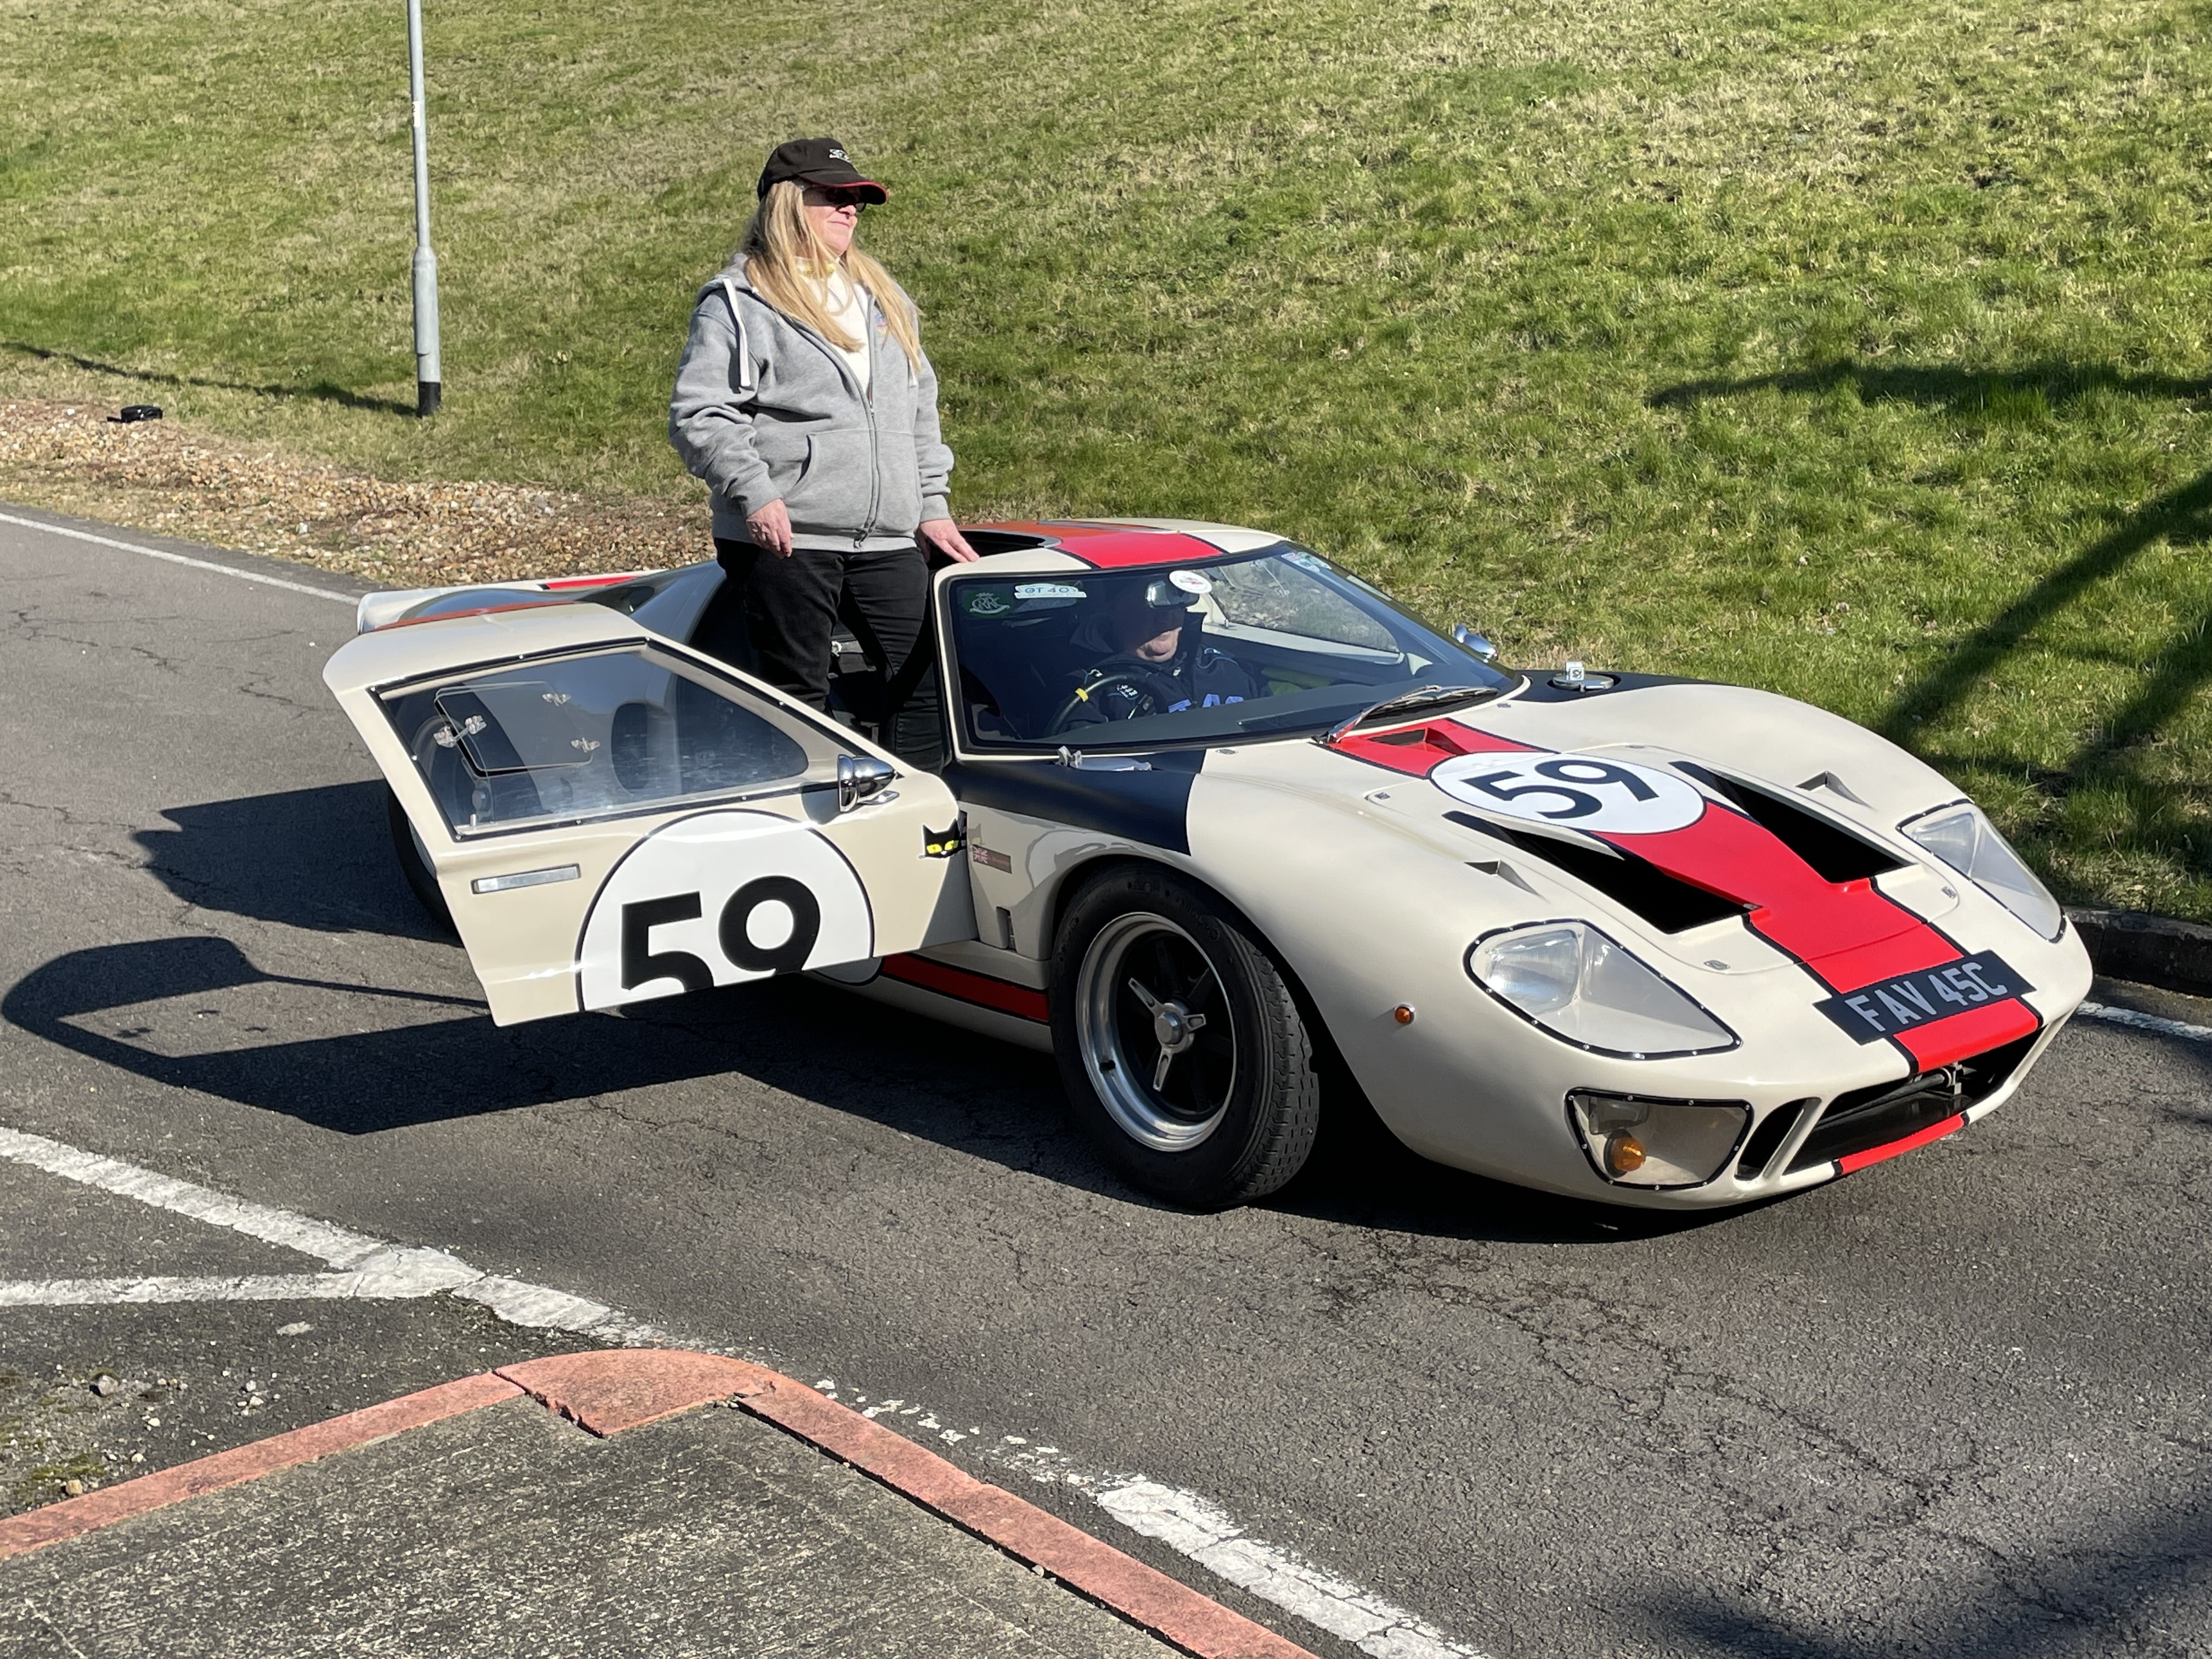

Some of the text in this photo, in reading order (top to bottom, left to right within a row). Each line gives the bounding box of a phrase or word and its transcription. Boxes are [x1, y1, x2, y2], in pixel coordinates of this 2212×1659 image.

[1460, 759, 1660, 819] 59
[622, 875, 821, 993] 59
[1844, 961, 2008, 1032] FAV 45C
